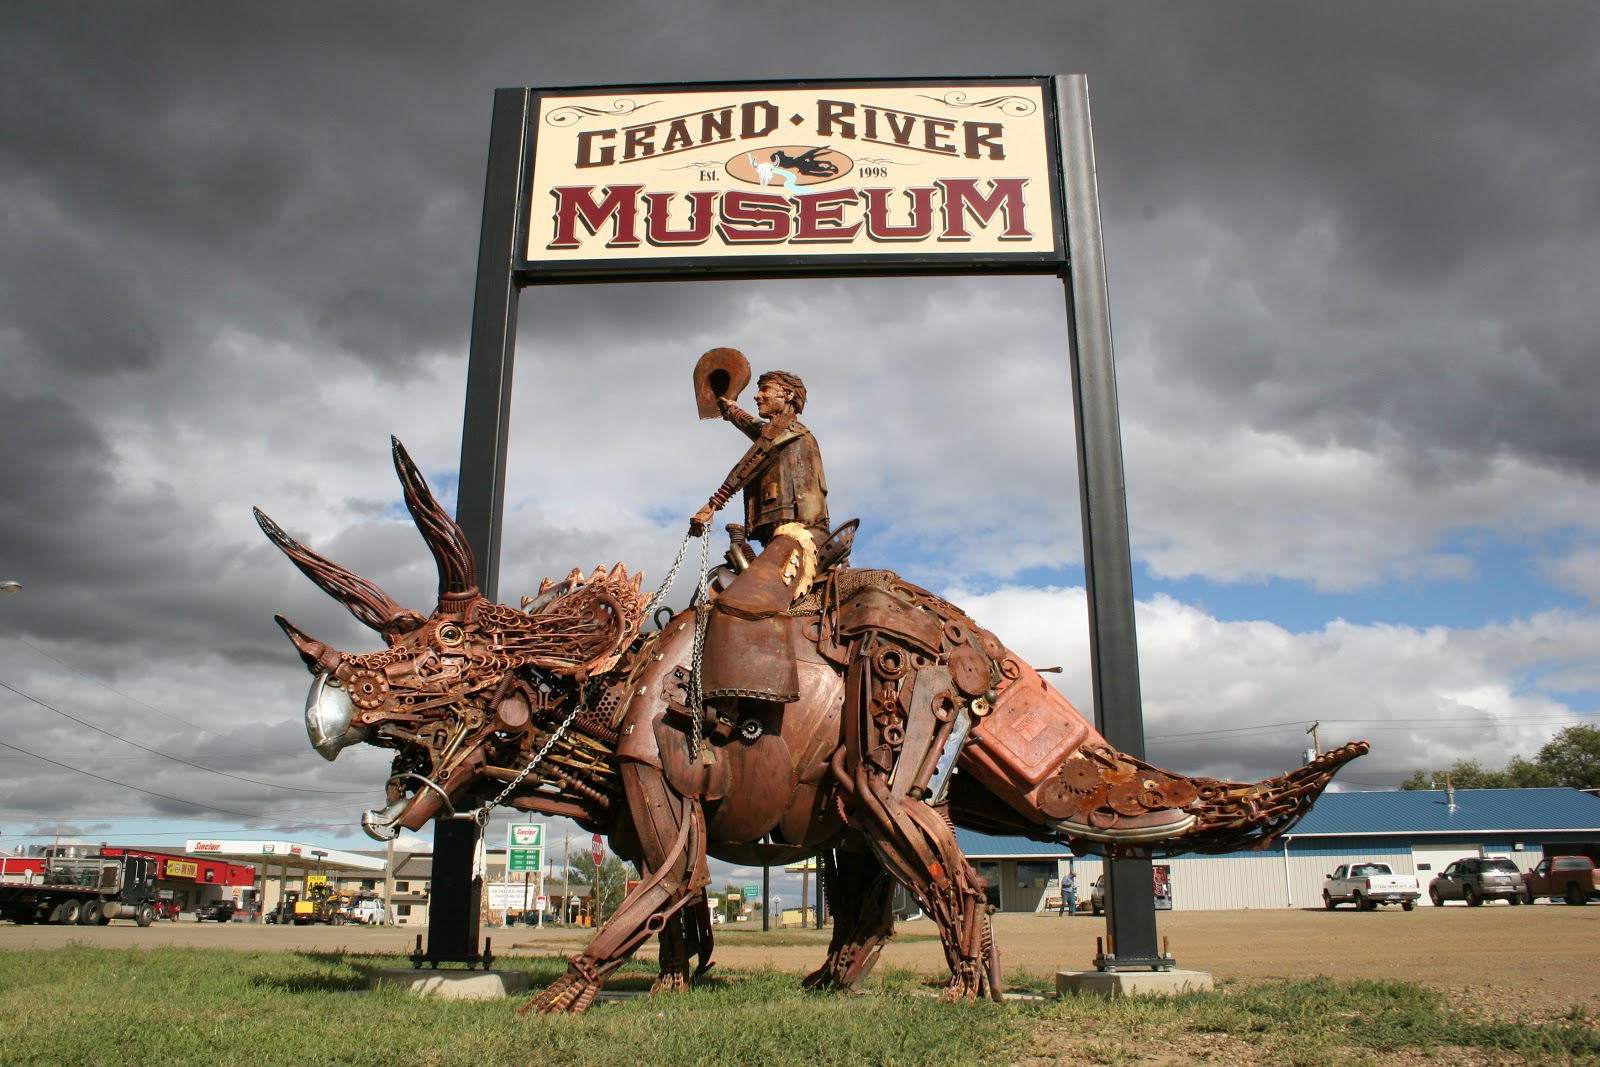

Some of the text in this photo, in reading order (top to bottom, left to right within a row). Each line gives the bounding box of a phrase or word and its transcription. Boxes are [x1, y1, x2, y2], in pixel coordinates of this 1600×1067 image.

[575, 98, 1006, 169] GRAND RIVER
[699, 169, 720, 182] Est.
[858, 166, 888, 178] 1998
[546, 177, 1035, 250] MUSEUM
[516, 828, 537, 836] Sinclair
[194, 842, 221, 851] Sinclair
[592, 840, 603, 855] STOP
